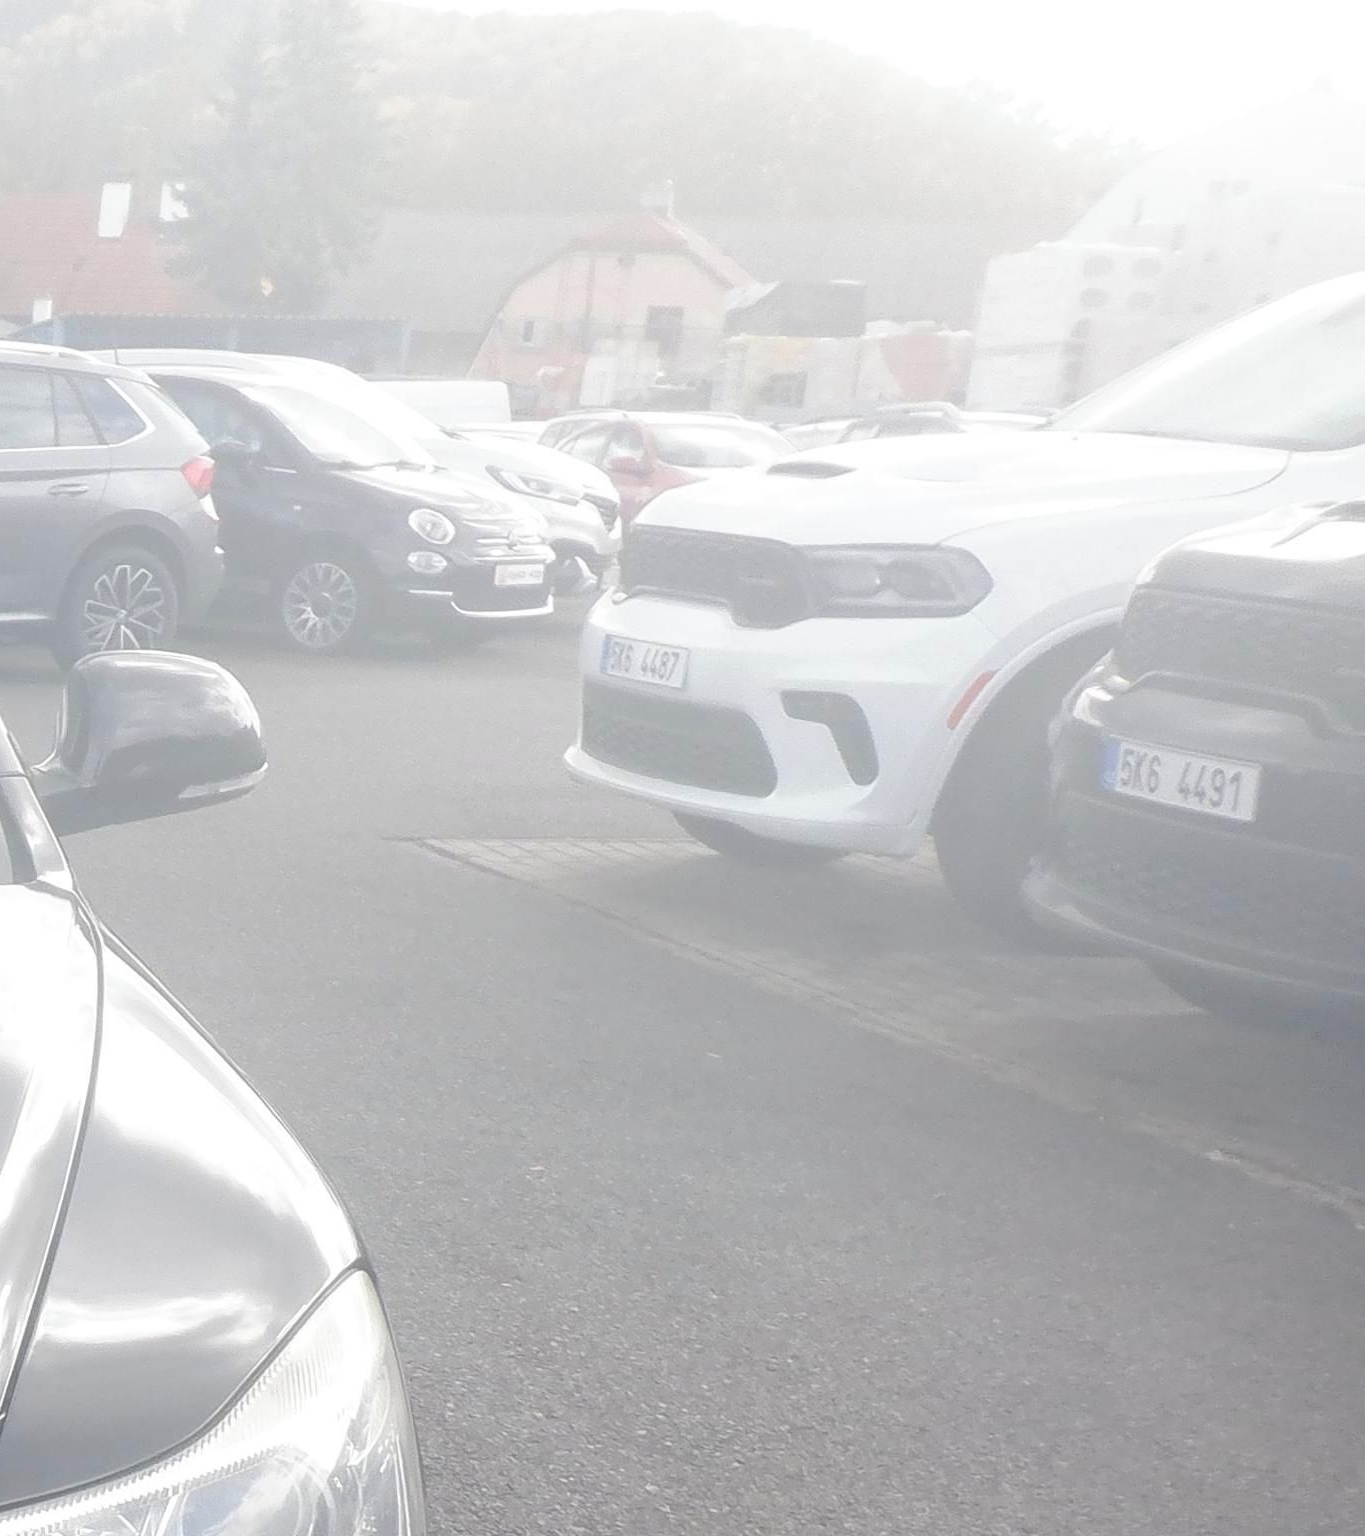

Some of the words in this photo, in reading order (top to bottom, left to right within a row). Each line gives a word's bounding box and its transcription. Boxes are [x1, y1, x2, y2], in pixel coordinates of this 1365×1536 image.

[640, 647, 680, 681] 4487
[1120, 749, 1162, 794] 5K6
[1178, 761, 1243, 812] 4491
